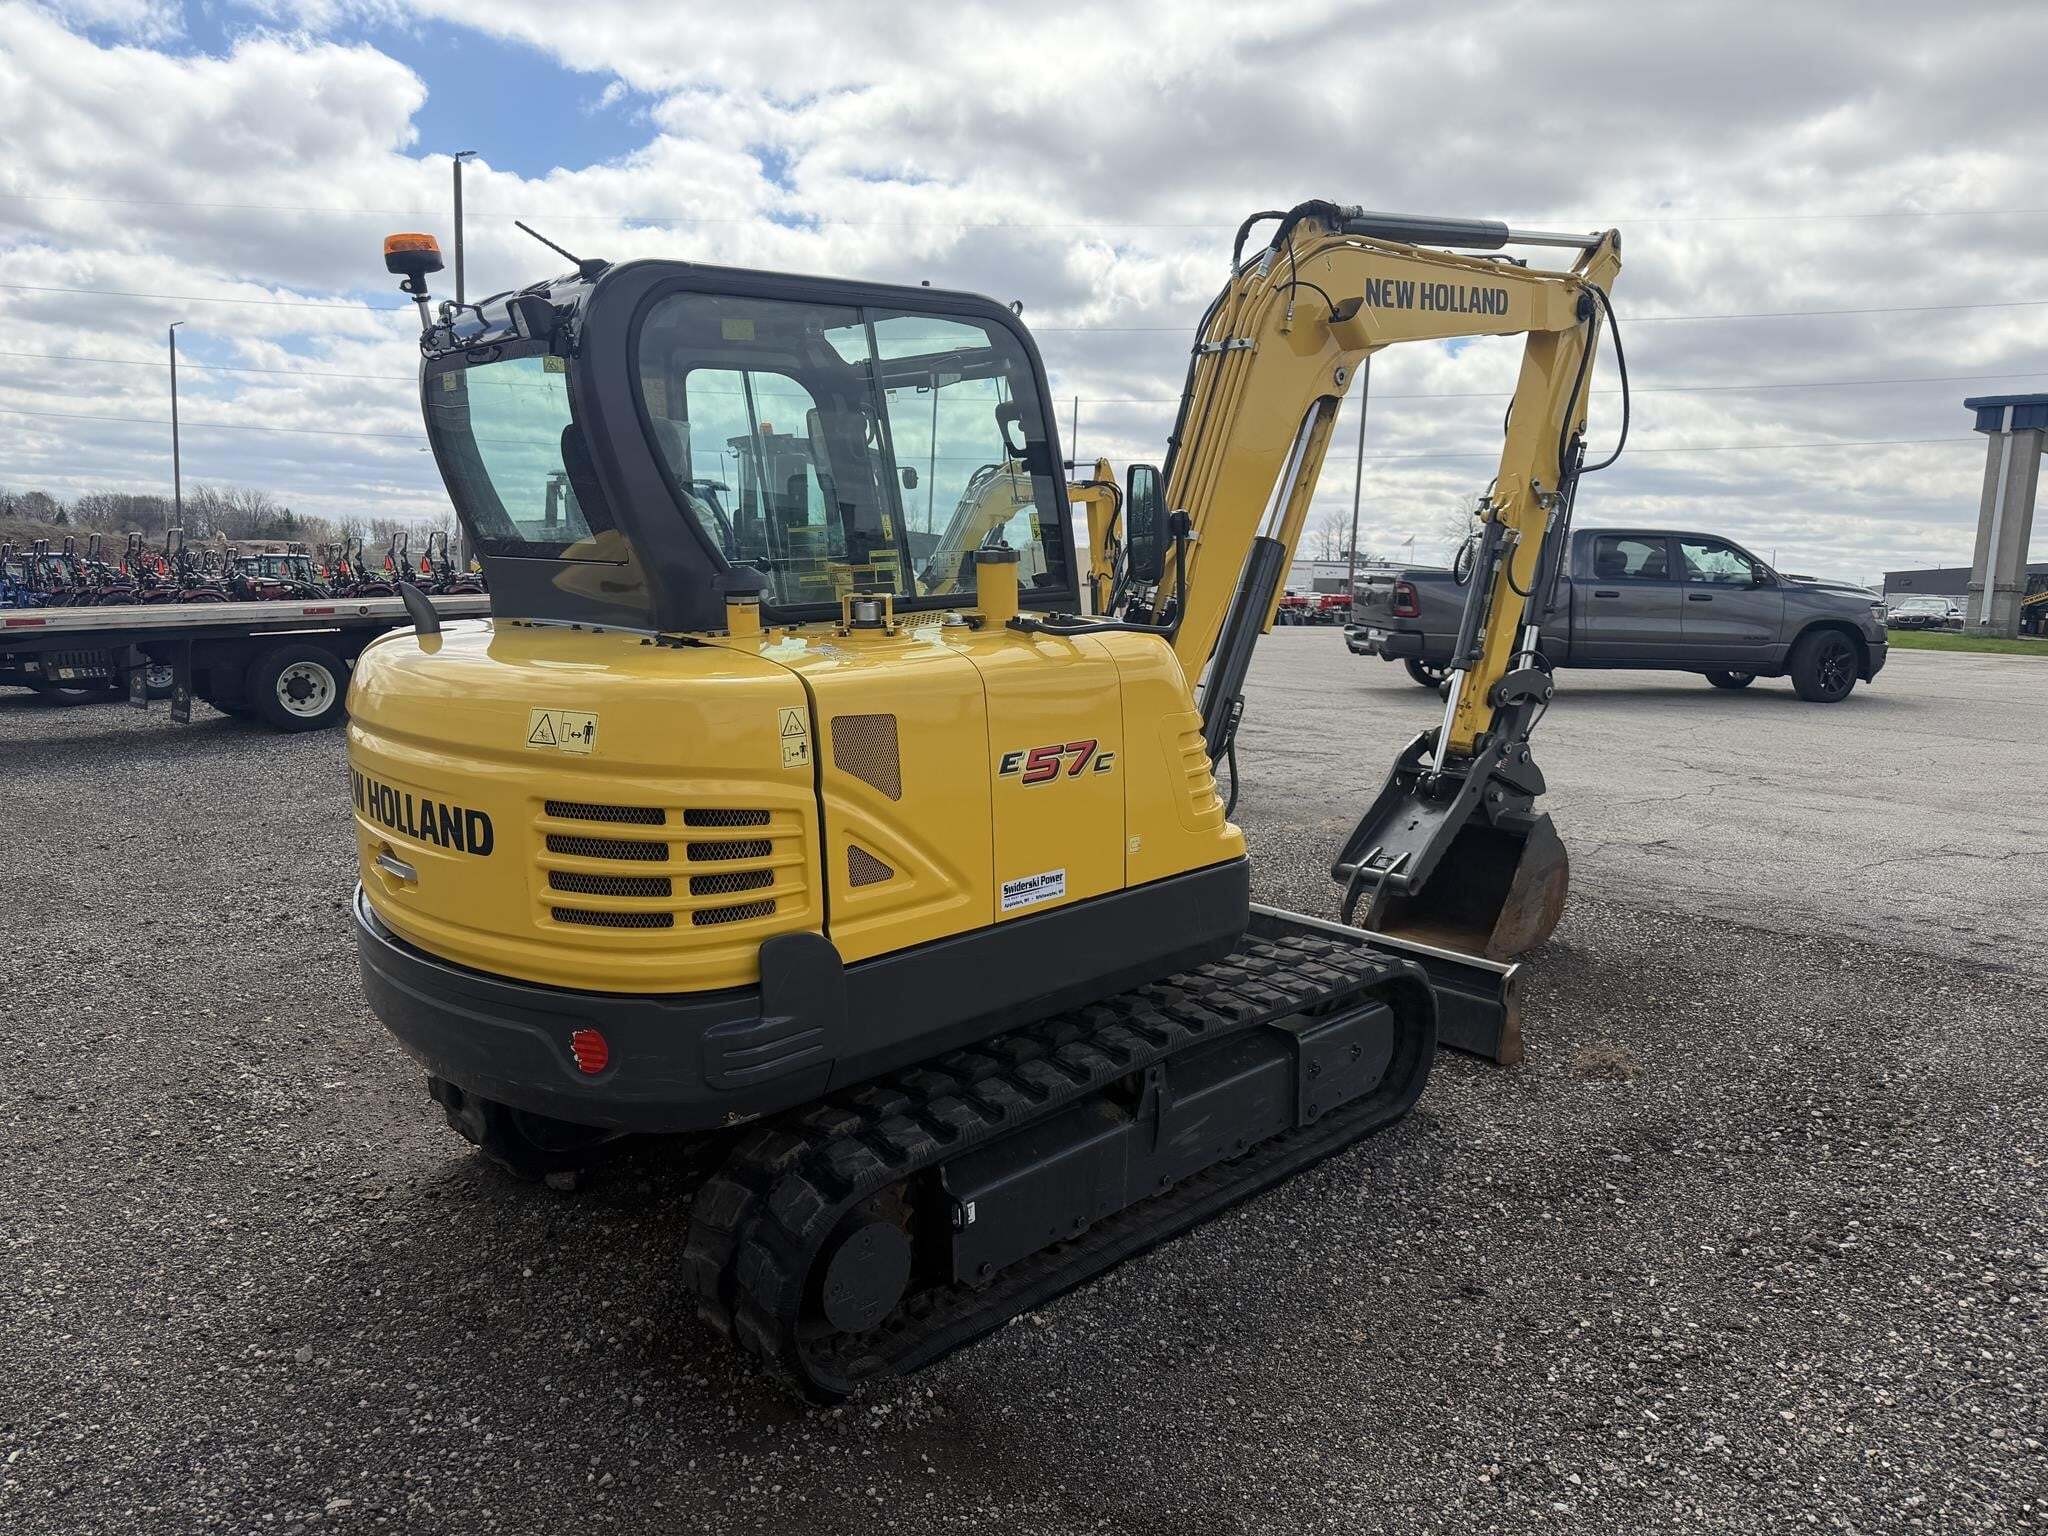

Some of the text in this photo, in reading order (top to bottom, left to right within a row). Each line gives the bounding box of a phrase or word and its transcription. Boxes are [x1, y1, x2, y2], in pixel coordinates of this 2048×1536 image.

[1365, 277, 1509, 316] NEW HOLLAND
[366, 777, 494, 857] HOLLAND
[1003, 877, 1040, 895] Swiderski
[1040, 873, 1064, 886] Power
